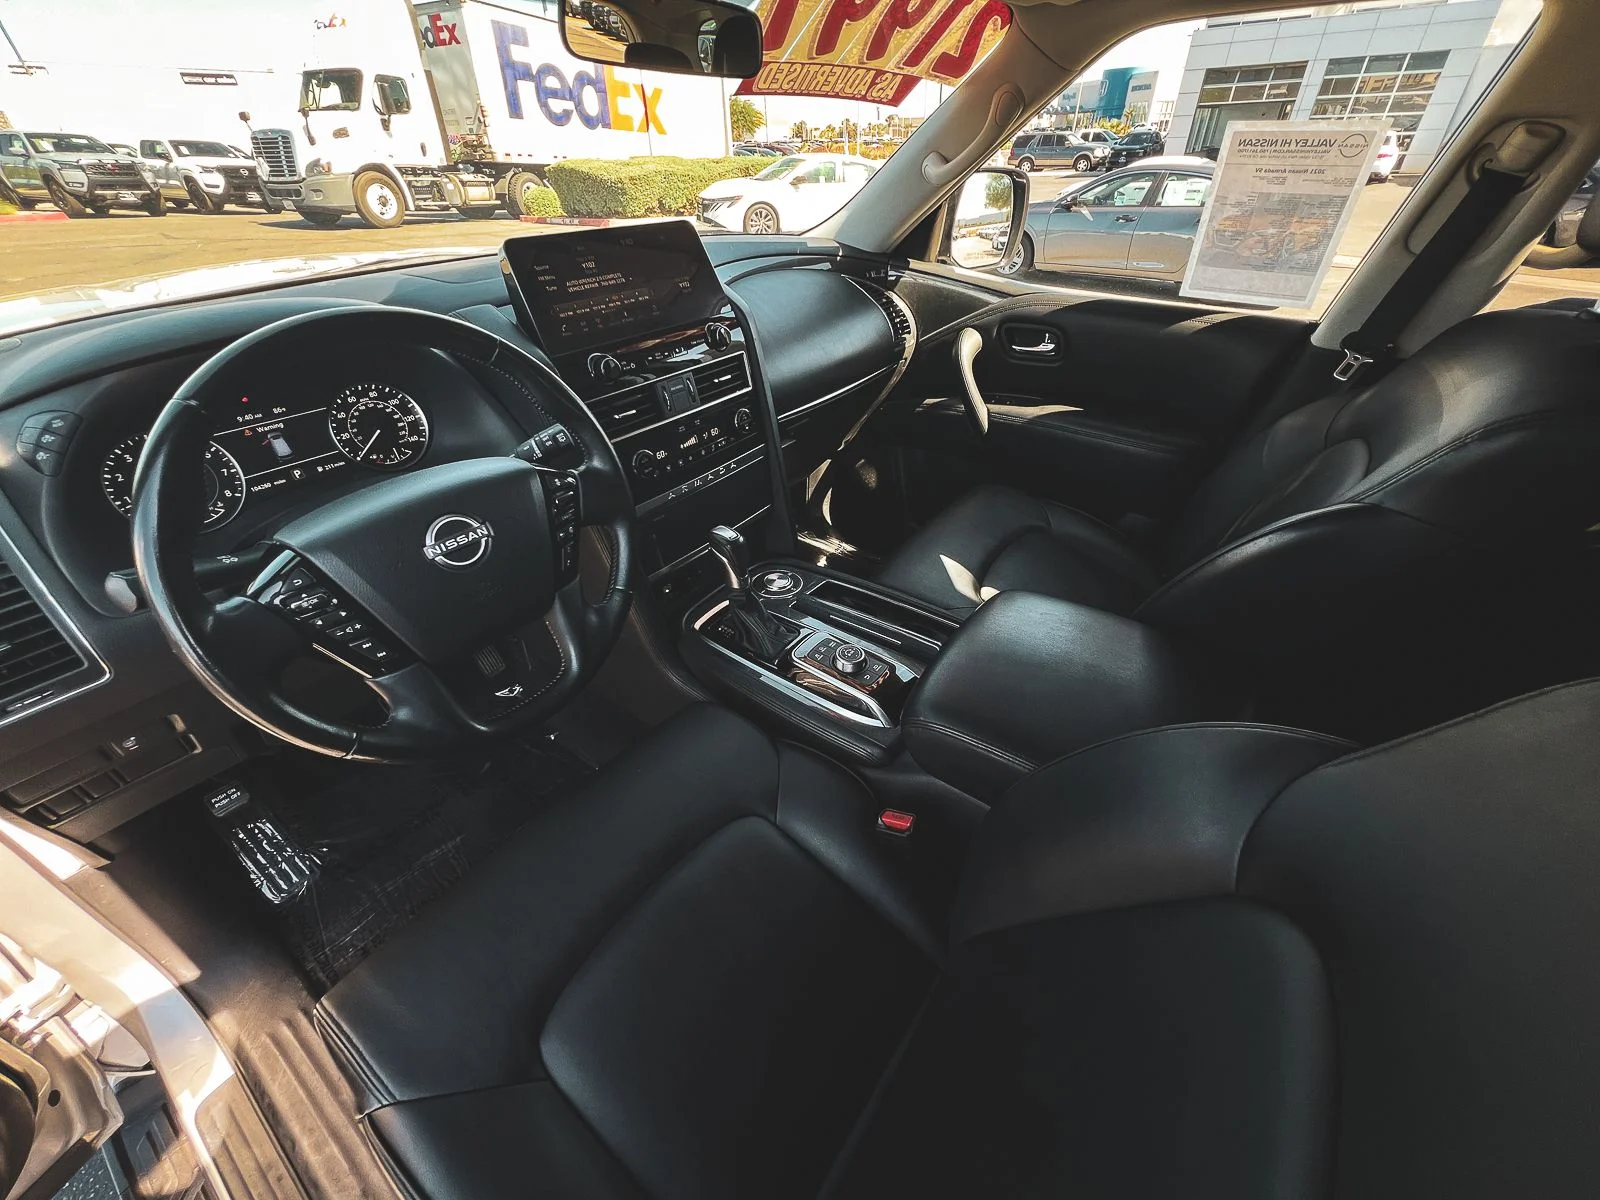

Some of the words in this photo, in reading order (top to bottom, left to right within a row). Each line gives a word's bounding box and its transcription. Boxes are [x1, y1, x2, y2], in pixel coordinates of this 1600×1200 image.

[490, 20, 667, 135] FedEx
[236, 413, 254, 422] 9:40
[256, 422, 284, 433] Warning
[340, 432, 350, 440] 20
[407, 435, 419, 443] 140
[123, 454, 133, 463] 3
[220, 468, 228, 476] 7
[293, 469, 301, 479] P
[114, 473, 125, 482] 2
[224, 489, 233, 497] 8
[427, 524, 489, 557] NISSAN
[211, 793, 227, 803] PUSH
[214, 797, 230, 808] PUSH
[230, 791, 241, 800] OFF
